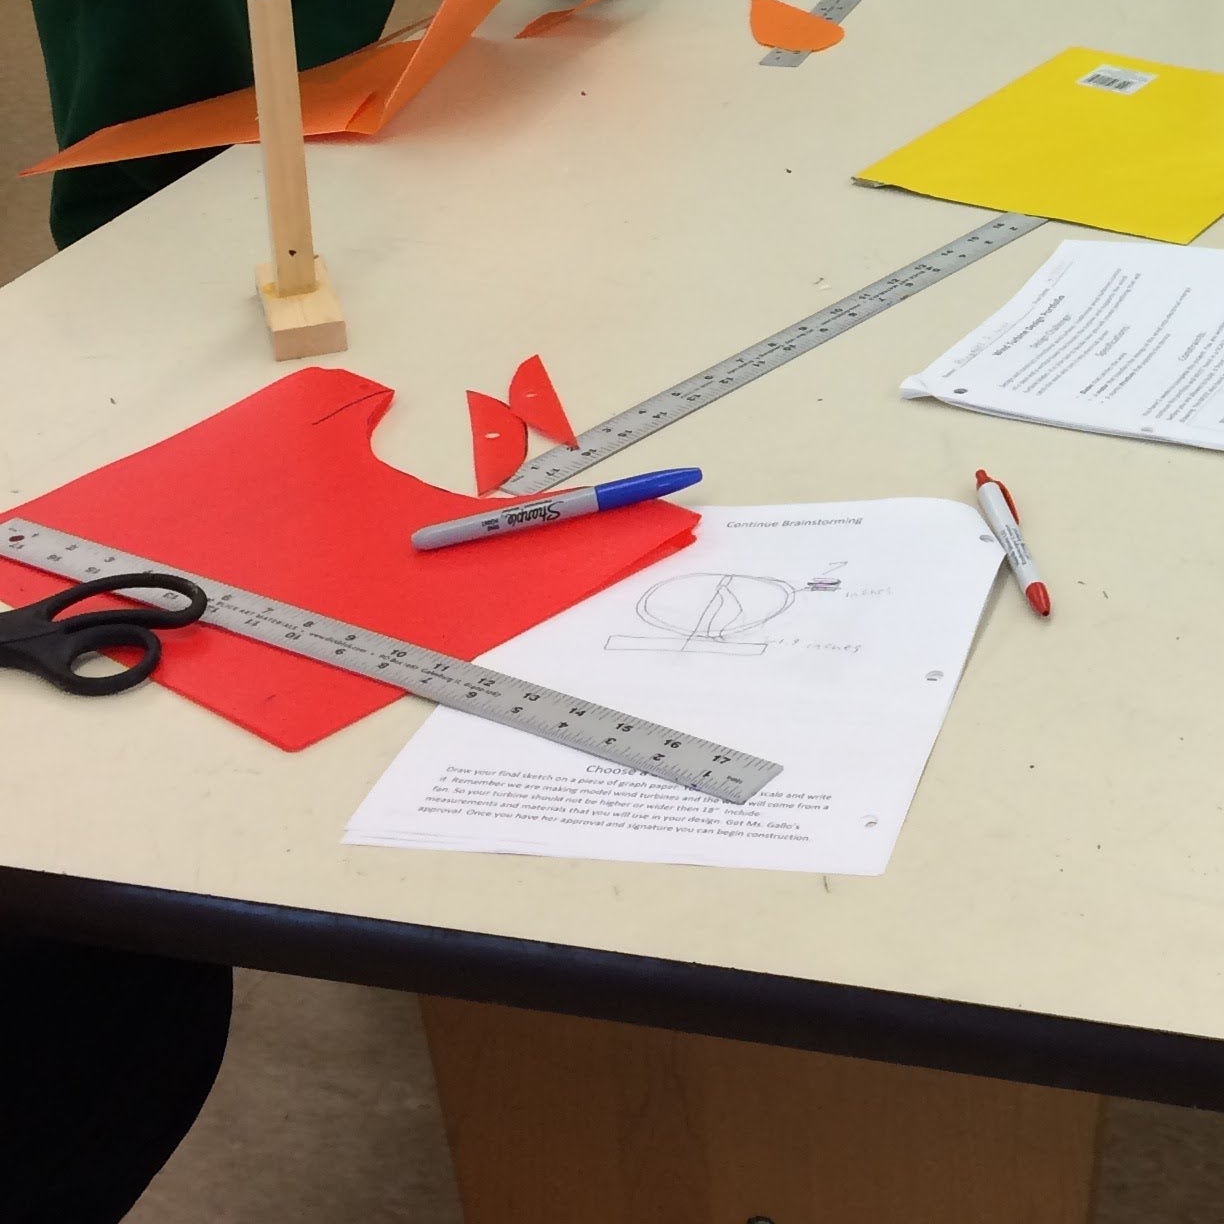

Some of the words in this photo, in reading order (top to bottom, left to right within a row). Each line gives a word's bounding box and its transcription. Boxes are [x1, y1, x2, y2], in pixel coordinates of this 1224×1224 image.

[506, 500, 564, 527] Sharpie
[727, 520, 779, 529] Continue
[781, 517, 863, 528] Brainstorming
[284, 632, 302, 641] 10
[604, 737, 617, 745] 3
[652, 753, 666, 762] 2
[390, 649, 407, 658] 10
[433, 663, 450, 672] 11
[477, 677, 496, 687] 12
[523, 692, 541, 702] 13
[568, 707, 586, 717] 14
[615, 722, 634, 733] 15
[664, 739, 682, 749] 16
[712, 754, 731, 765] 17
[446, 766, 472, 775] Draw
[473, 769, 497, 778] your
[498, 770, 521, 779] final
[522, 772, 553, 782] sketch
[577, 777, 605, 787] piece
[606, 778, 618, 787] of
[618, 779, 648, 790] graph
[586, 764, 636, 776] Choose
[451, 777, 505, 788] Remember
[507, 781, 522, 789] we
[542, 784, 577, 795] making
[580, 787, 612, 796] model
[613, 789, 638, 798] wind
[639, 792, 680, 801] turbines
[682, 794, 701, 803] and
[703, 795, 720, 804] the
[452, 787, 466, 795] So
[467, 790, 491, 798] your
[492, 790, 528, 800] turbine
[530, 793, 564, 802] should
[584, 798, 598, 806] be
[599, 799, 631, 810] higher
[646, 802, 674, 812] wider
[723, 808, 761, 817] Include
[760, 791, 784, 799] scale
[786, 792, 805, 800] and
[807, 793, 832, 801] write
[425, 796, 499, 807] measurements
[499, 801, 520, 809] and
[521, 803, 567, 813] materials
[568, 806, 591, 815] that
[592, 809, 611, 817] you
[612, 810, 630, 818] will
[663, 816, 687, 824] your
[725, 819, 745, 827] Get
[748, 800, 766, 808] will
[797, 802, 820, 810] from
[466, 808, 493, 817] Once
[494, 812, 513, 820] you
[515, 812, 539, 821] have
[541, 814, 558, 823] her
[560, 817, 604, 827] approval
[605, 820, 626, 828] and
[627, 823, 674, 833] signature
[675, 826, 694, 835] you
[716, 828, 745, 838] begin
